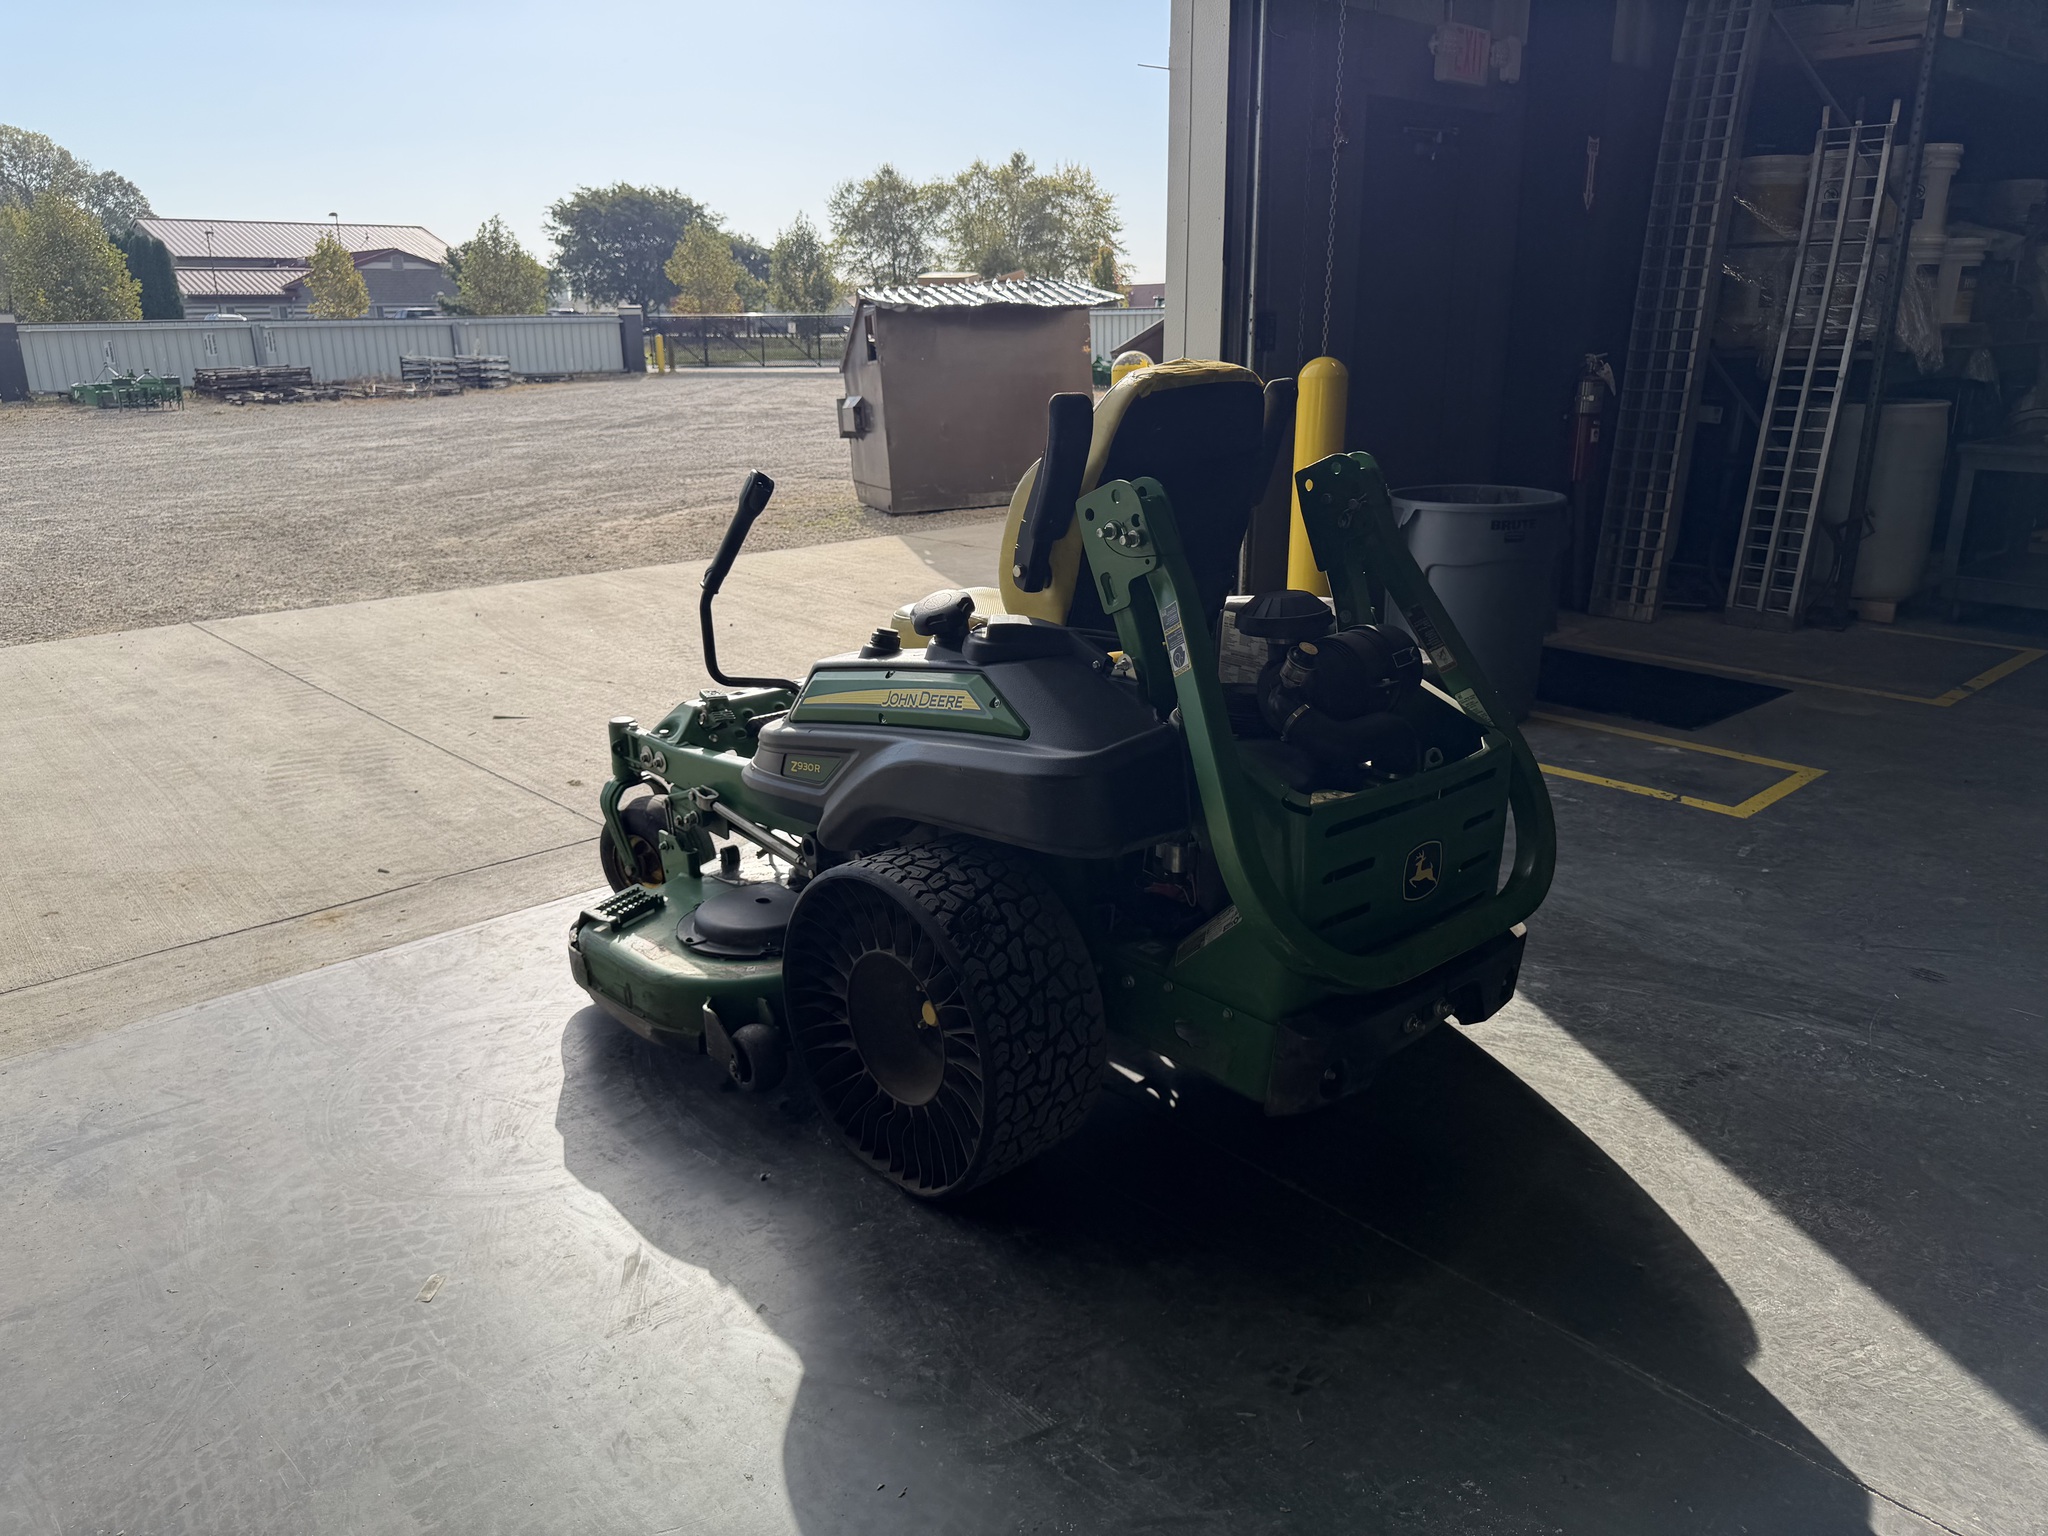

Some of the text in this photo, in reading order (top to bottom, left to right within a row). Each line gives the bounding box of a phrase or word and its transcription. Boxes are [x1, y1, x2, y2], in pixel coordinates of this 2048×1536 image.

[1491, 519, 1537, 530] BRUTE
[882, 690, 965, 709] JOHN DEERE
[791, 760, 821, 773] Z930R
